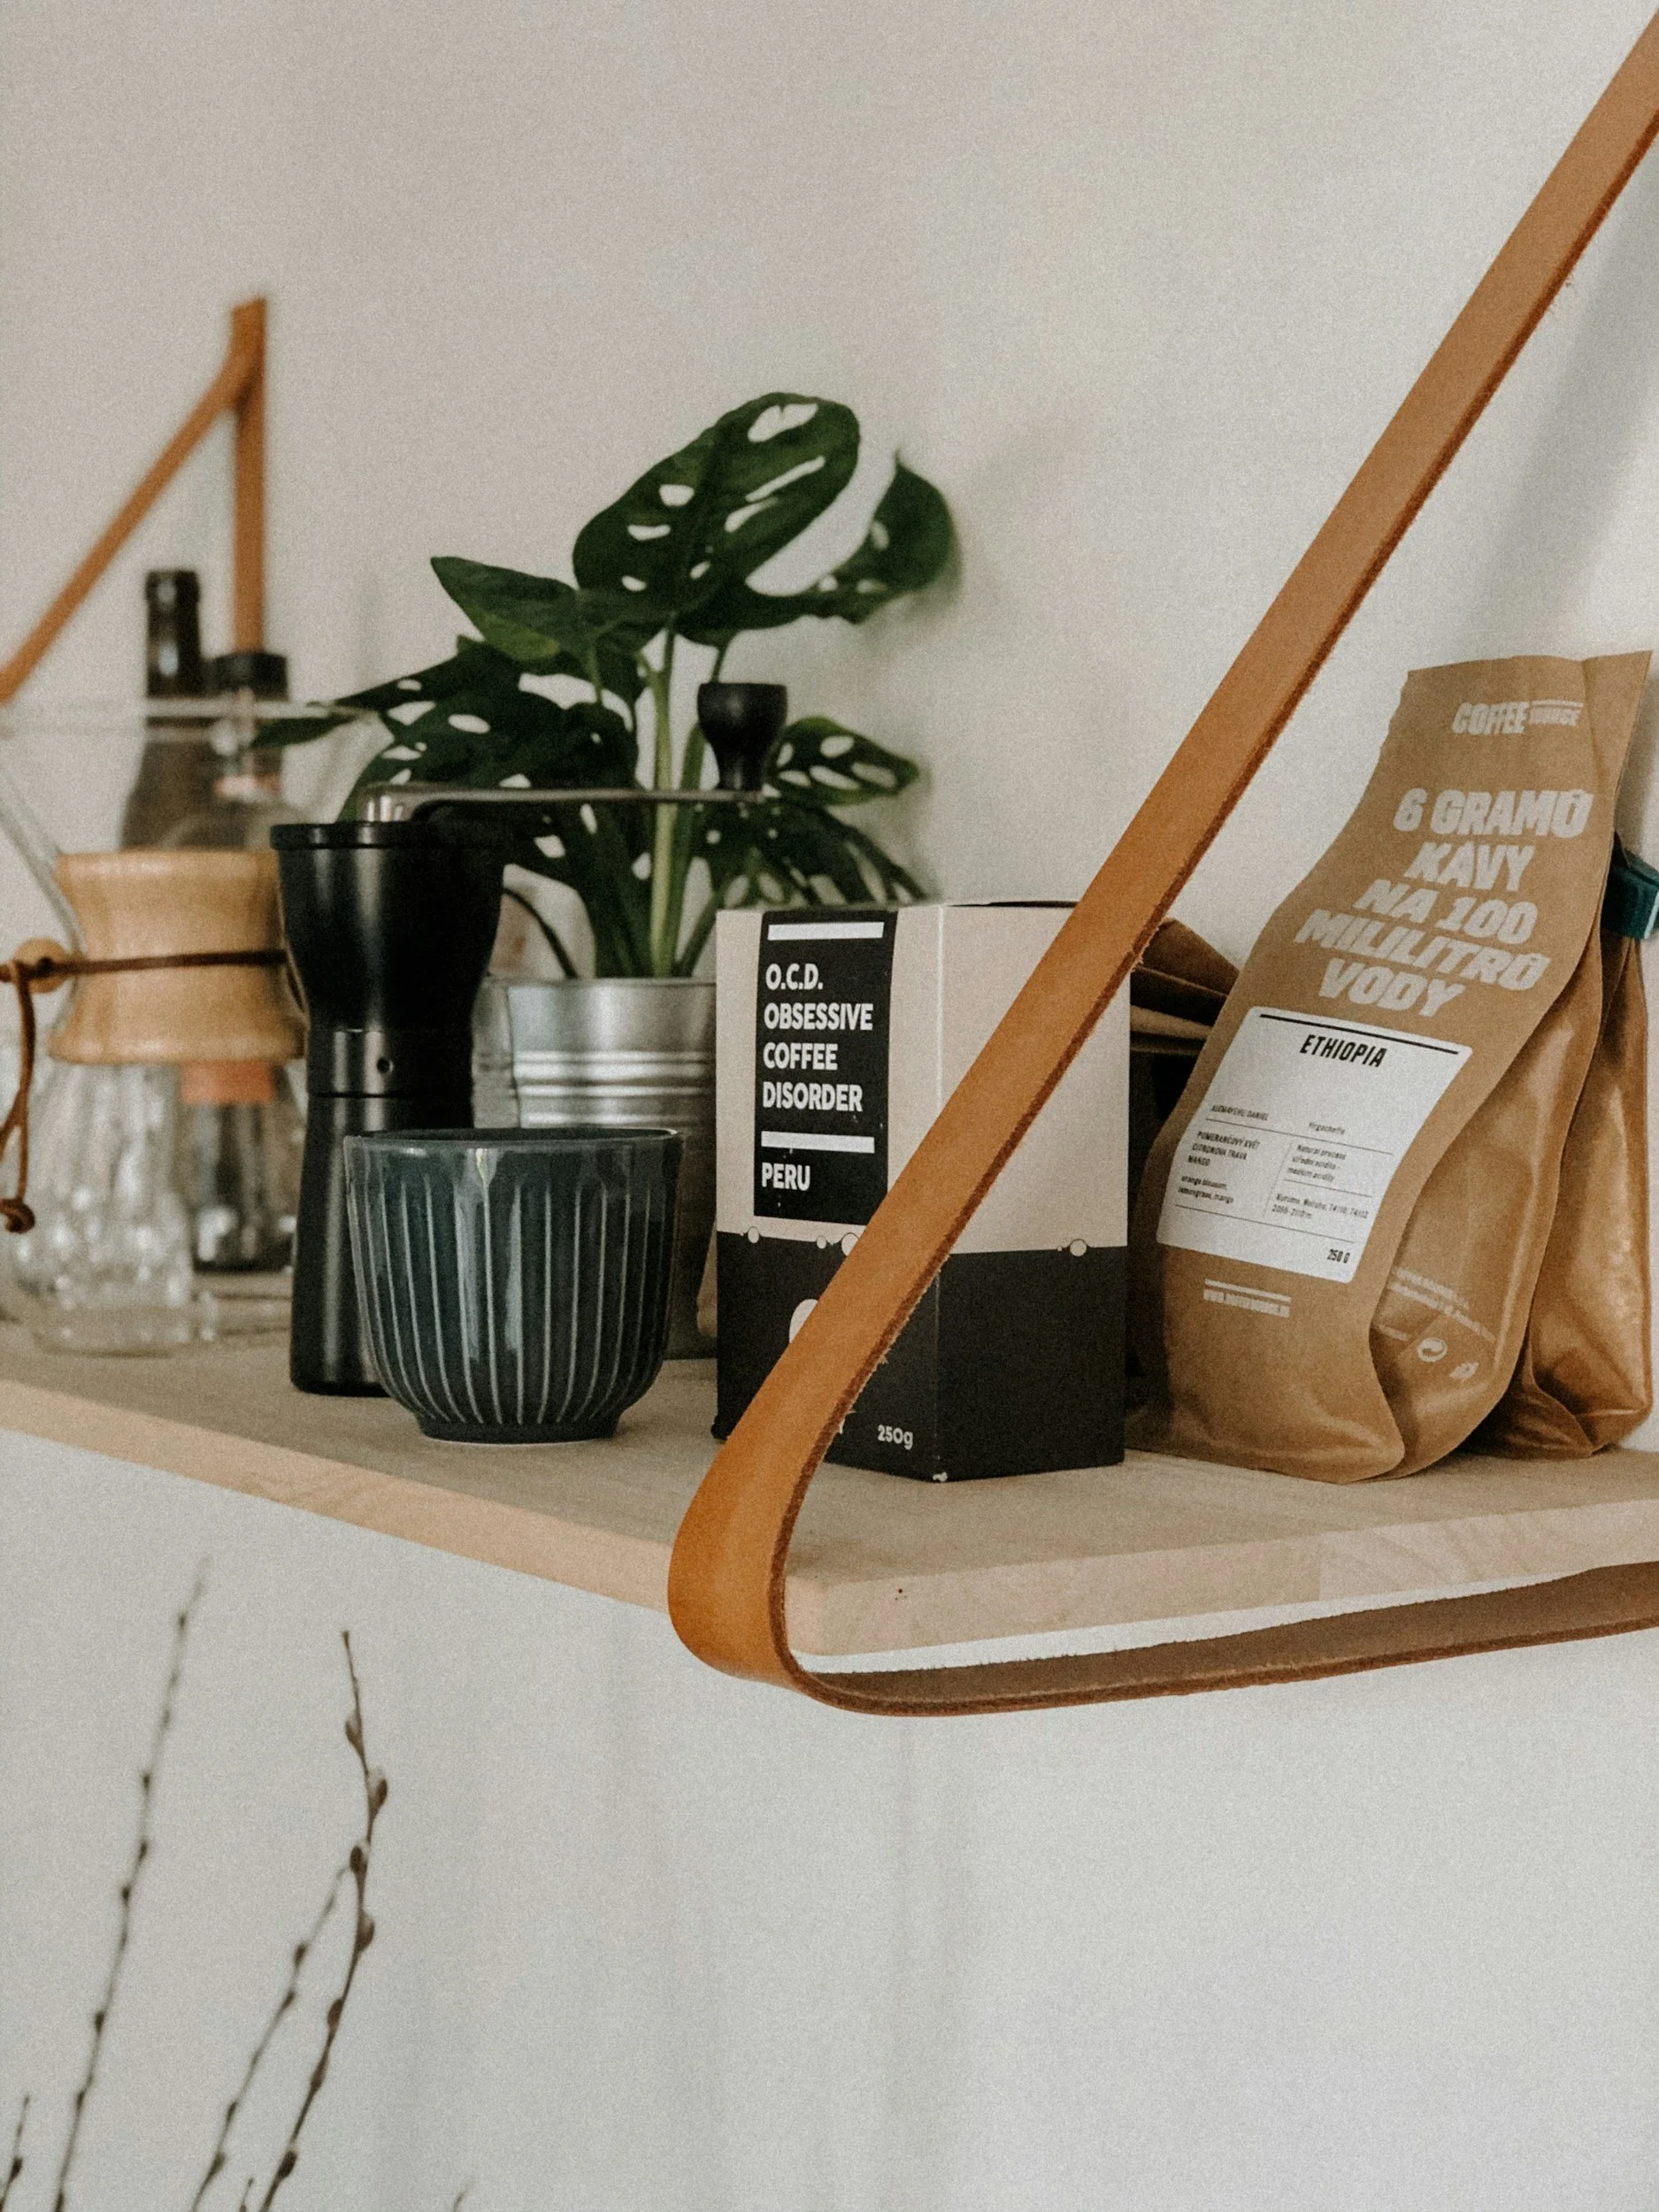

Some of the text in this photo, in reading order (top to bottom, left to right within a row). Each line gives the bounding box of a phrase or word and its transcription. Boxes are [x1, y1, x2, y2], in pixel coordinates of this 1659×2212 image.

[1452, 701, 1529, 734] COFFEE
[1393, 788, 1427, 832] 6
[1352, 879, 1538, 945] NA 100
[765, 964, 823, 990] O.C.D.
[1318, 958, 1466, 1018] VODY
[764, 1002, 873, 1031] OBSESSIVE
[763, 1042, 838, 1071] COFFEE
[1300, 1034, 1387, 1067] ETHIOPIA
[763, 1081, 863, 1112] DISORDER
[761, 1163, 810, 1191] PERU
[1327, 1248, 1343, 1263] 250
[877, 1425, 913, 1450] 250g
